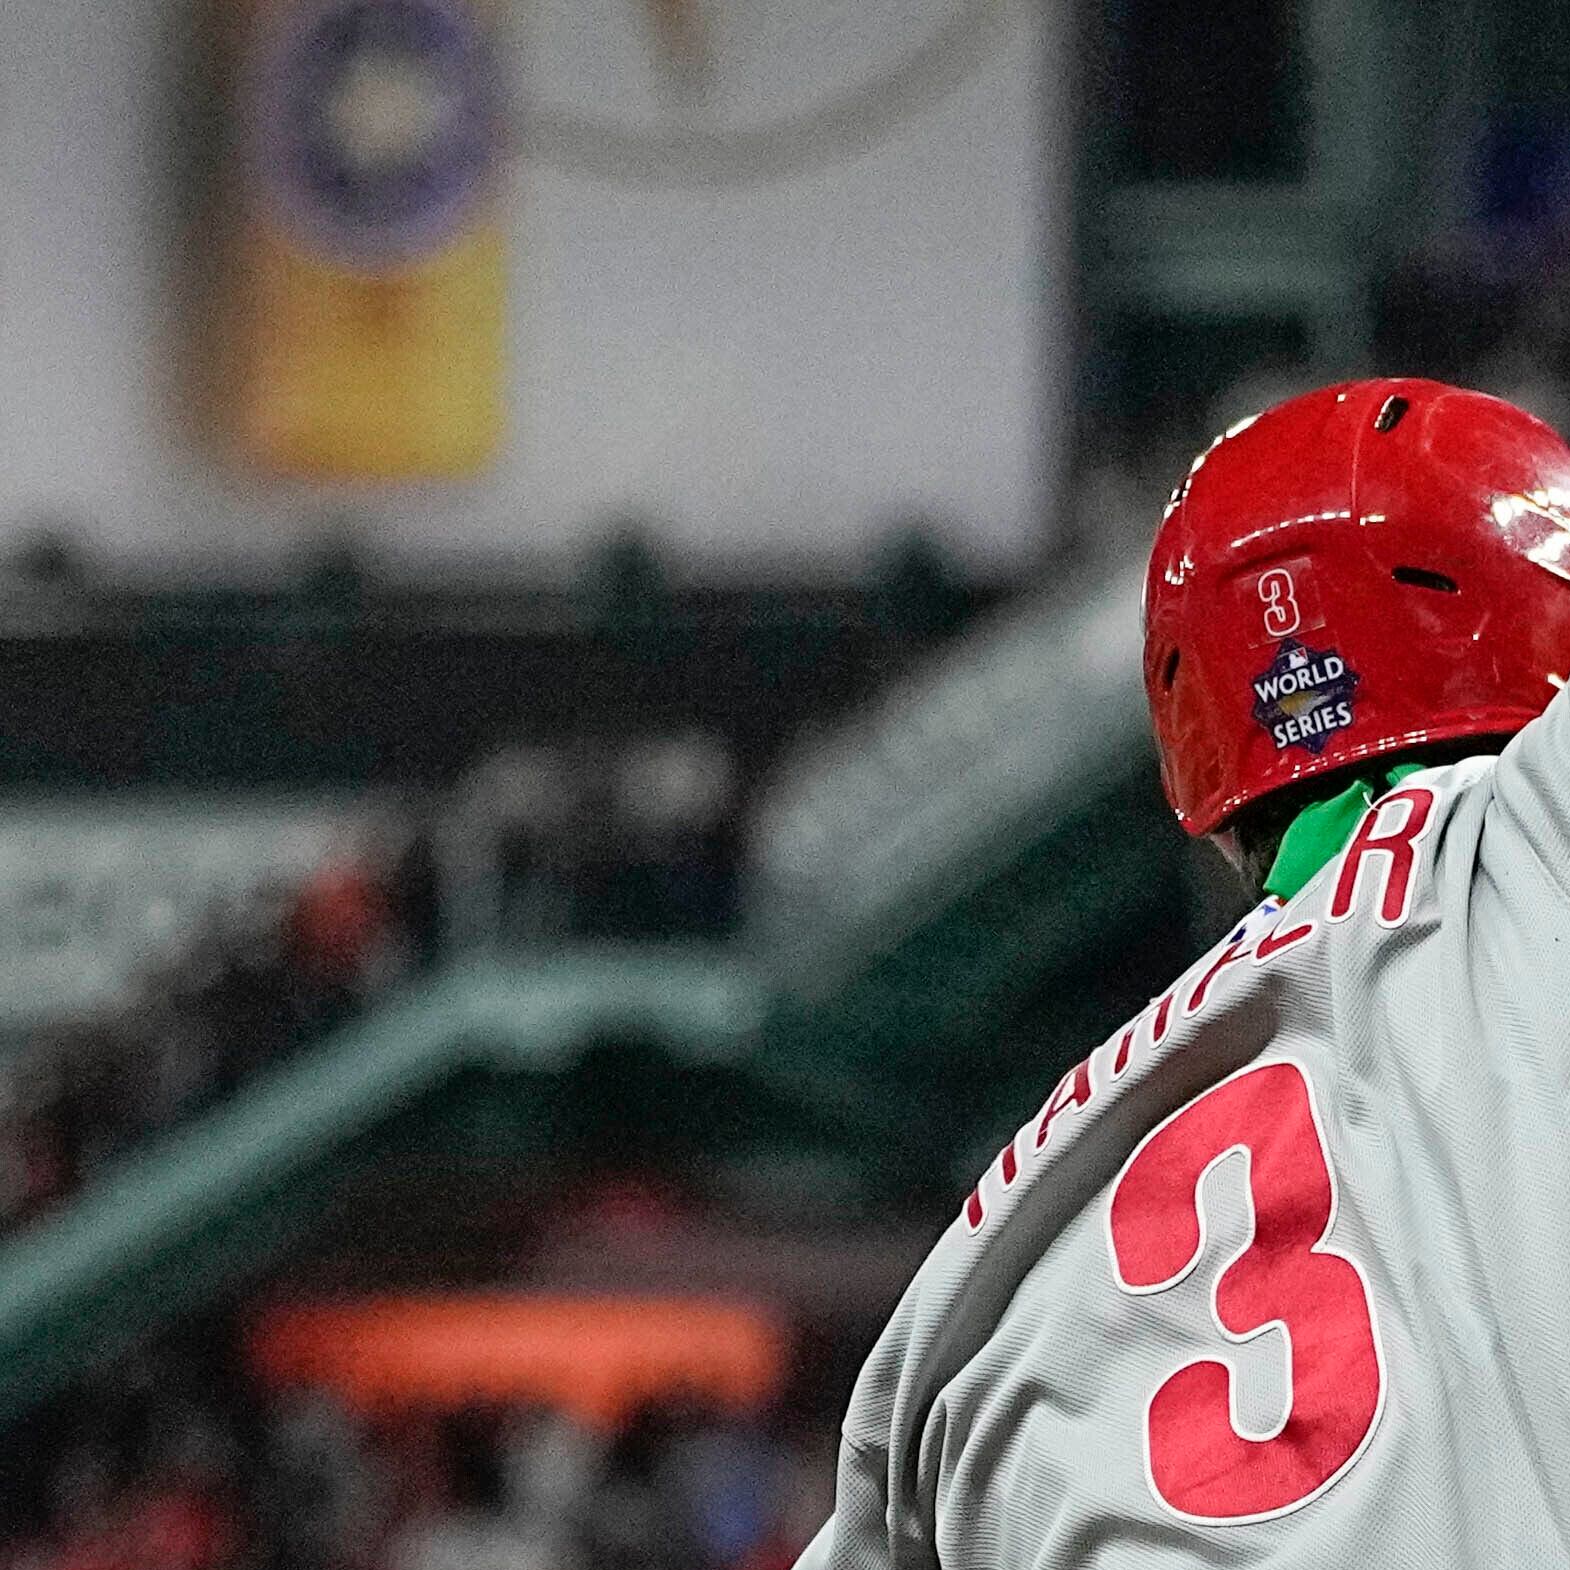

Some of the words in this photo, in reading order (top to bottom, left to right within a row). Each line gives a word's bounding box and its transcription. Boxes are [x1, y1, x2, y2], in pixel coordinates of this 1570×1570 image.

[1257, 568, 1300, 637] 3
[1254, 656, 1345, 703] WORLD
[1273, 701, 1353, 749] SERIES
[1104, 1056, 1388, 1526] 3
